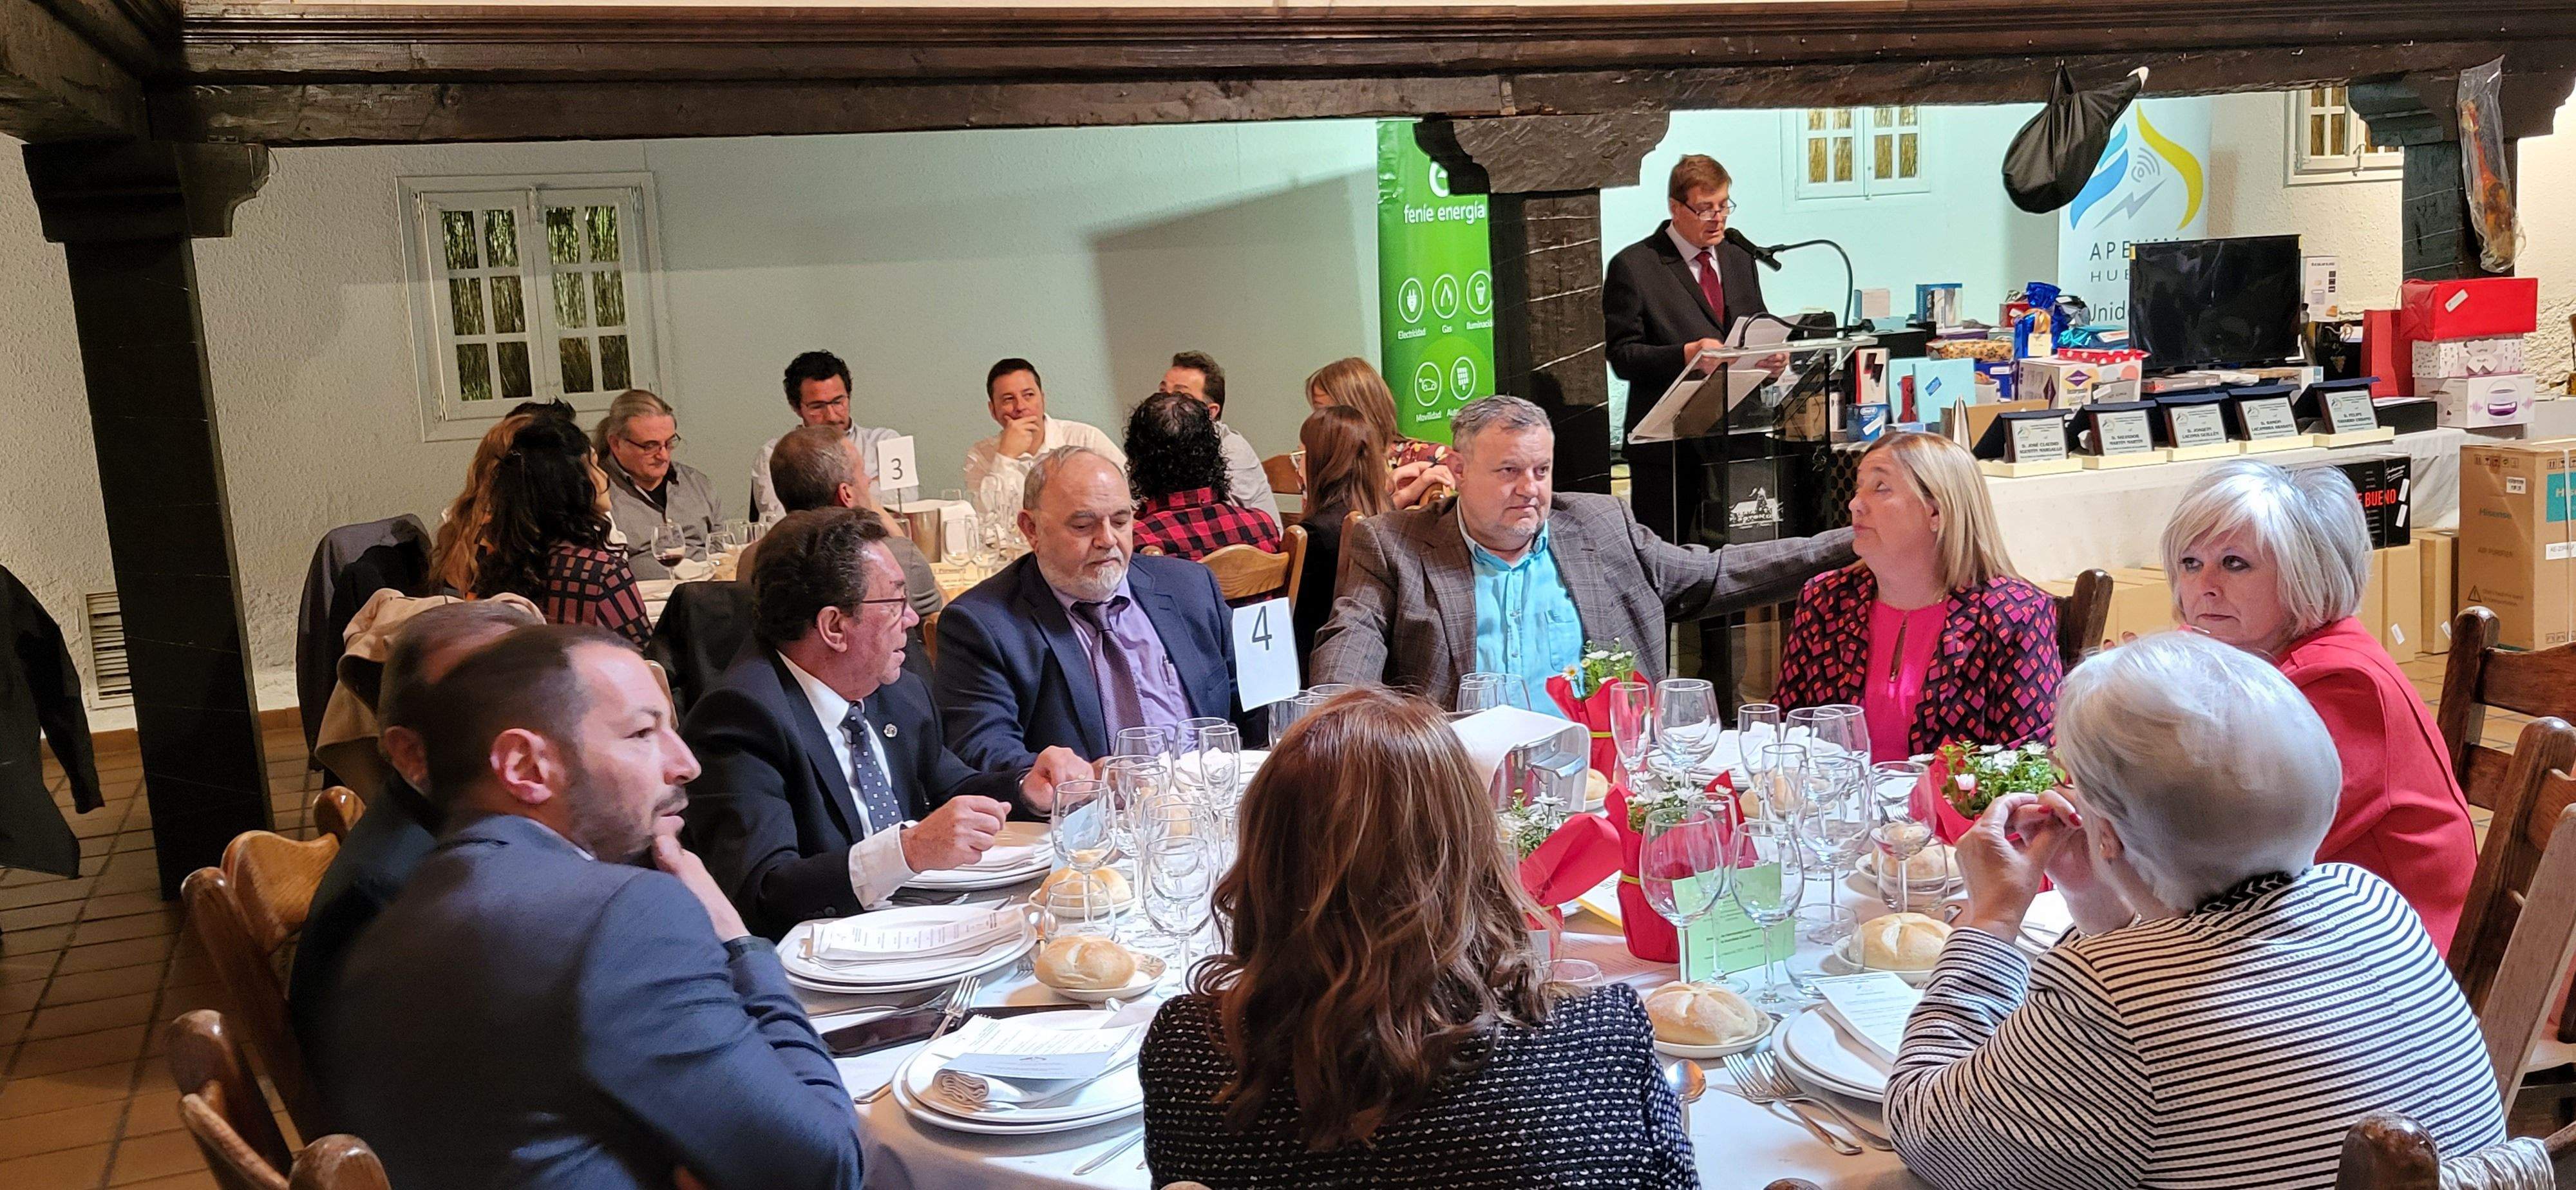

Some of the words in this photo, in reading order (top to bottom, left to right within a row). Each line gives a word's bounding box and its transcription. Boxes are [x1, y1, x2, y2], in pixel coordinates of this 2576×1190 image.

[1437, 200, 1486, 224] energía
[1397, 327, 1426, 339] Electricidad
[1442, 325, 1452, 333] Gas
[891, 458, 903, 480] 3
[2365, 489, 2396, 507] BUENO
[1252, 605, 1272, 650] 4
